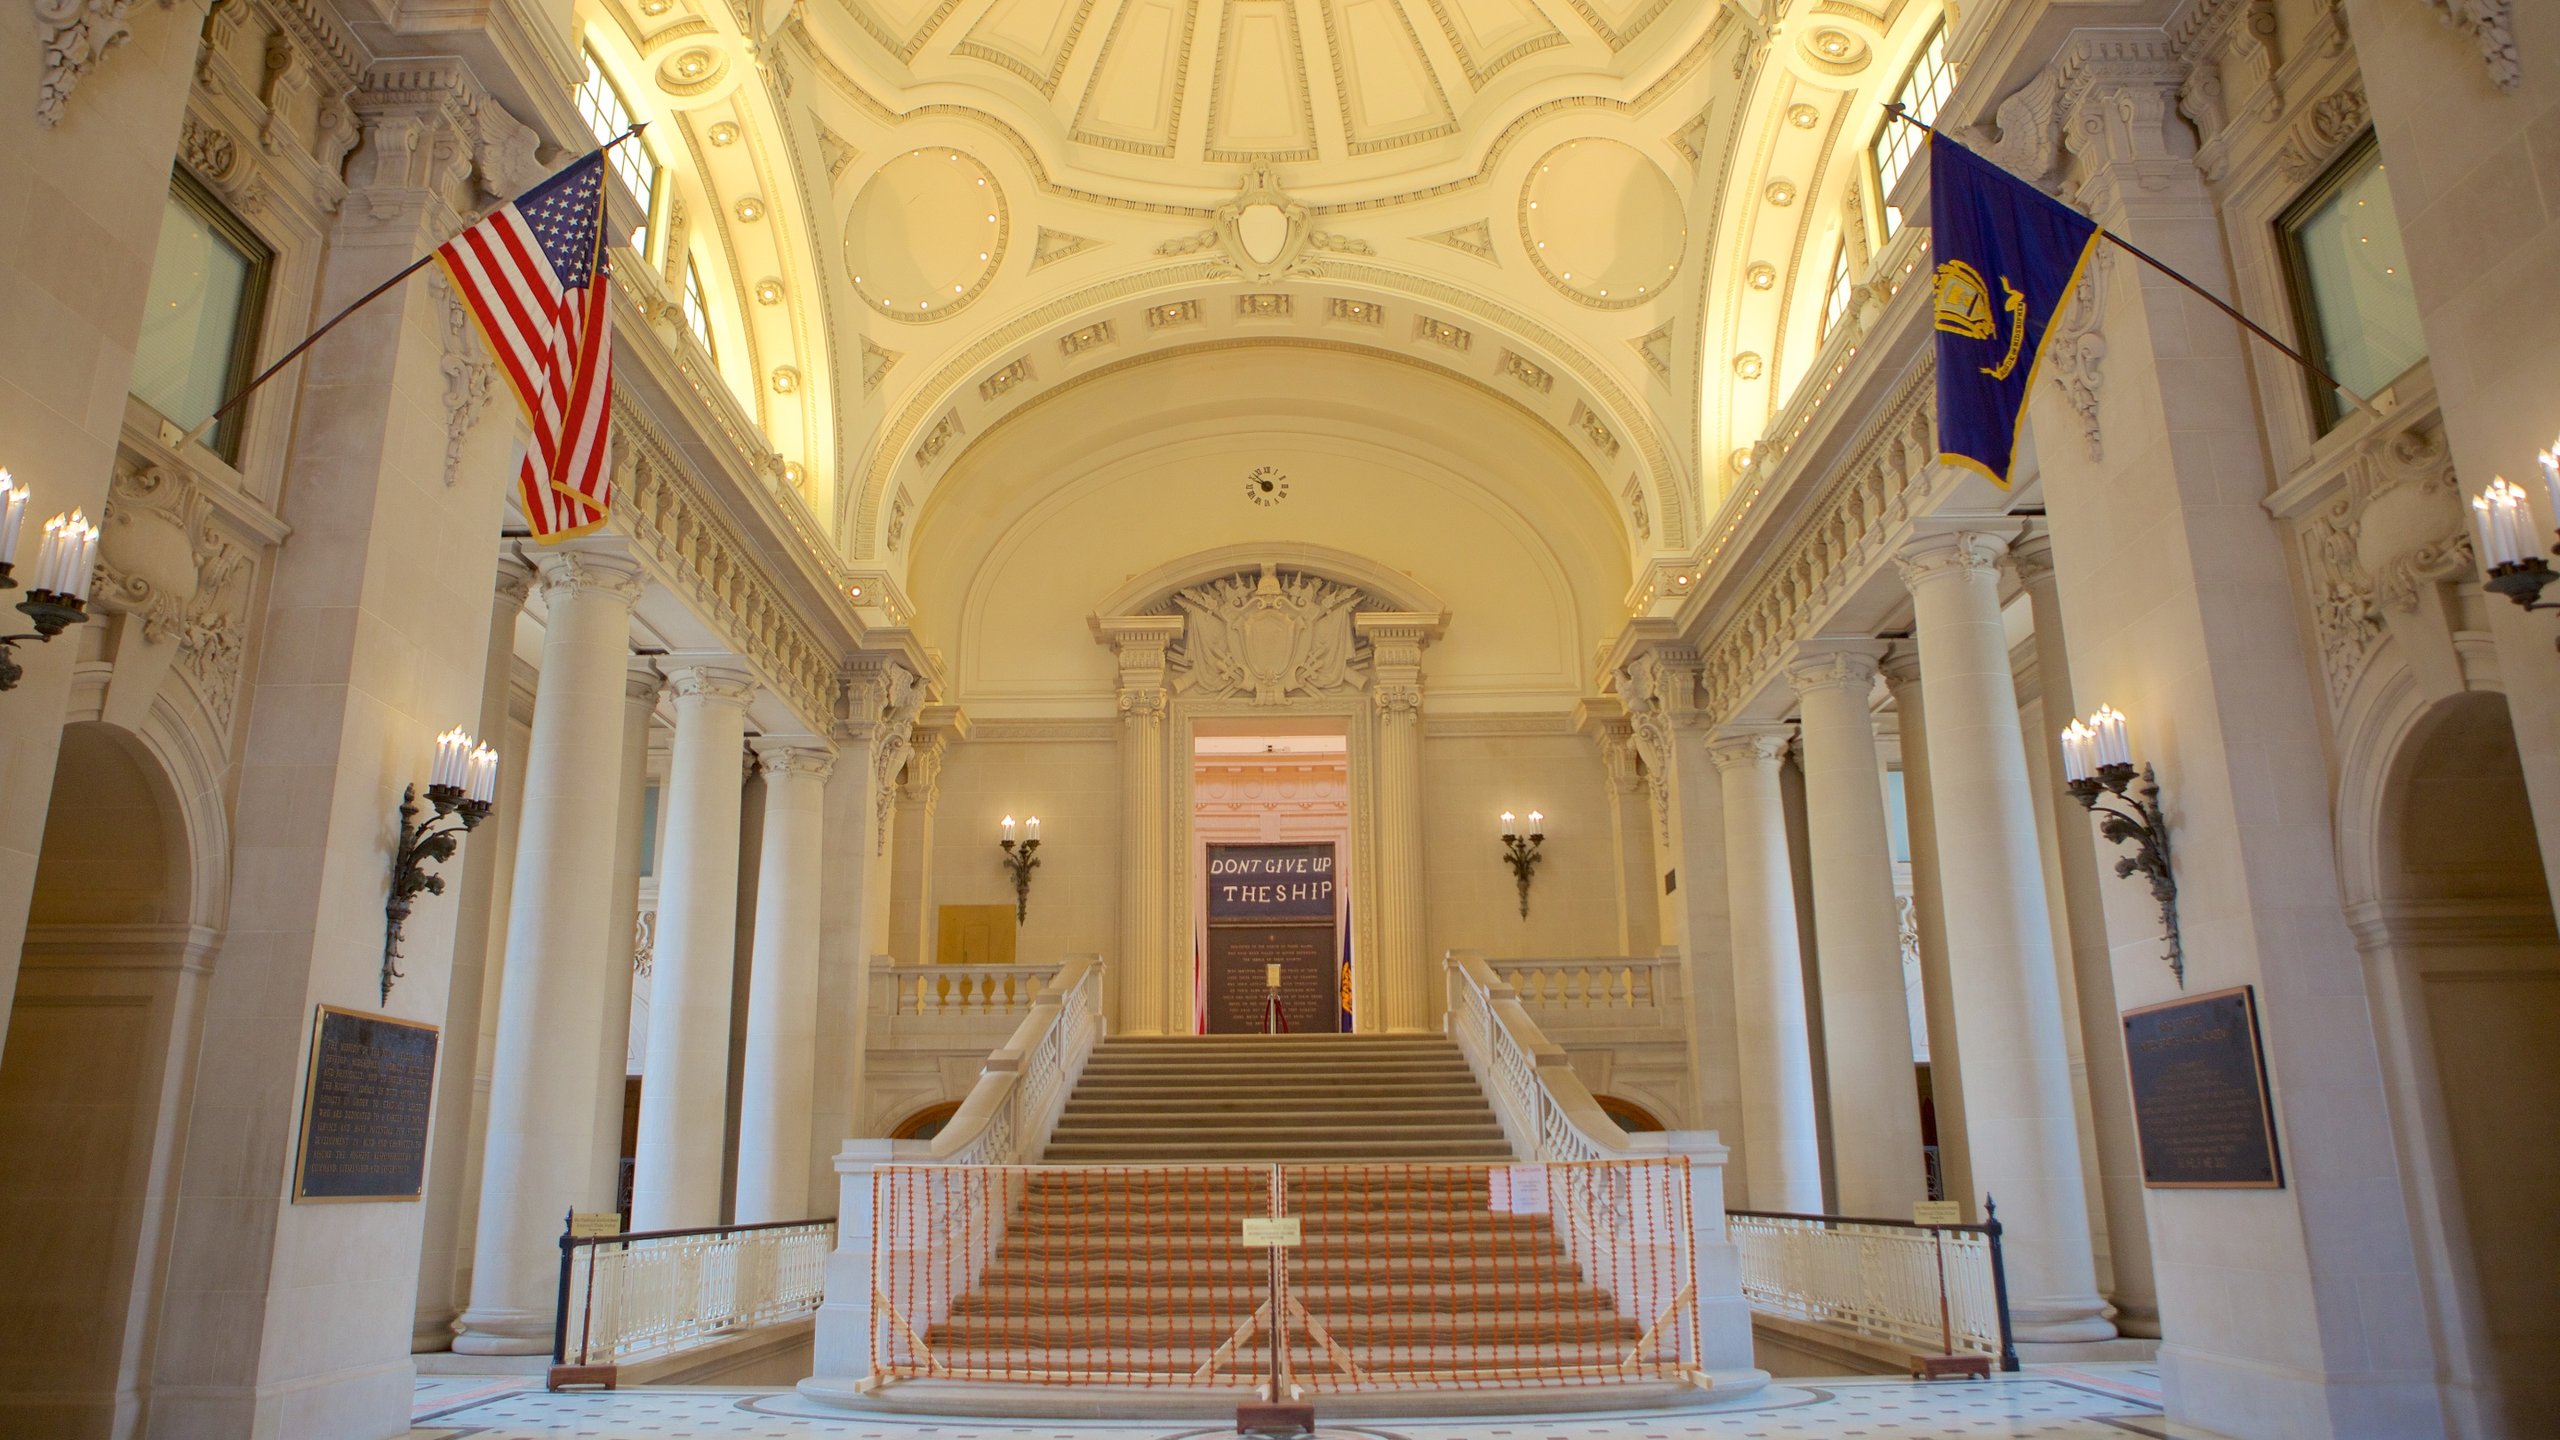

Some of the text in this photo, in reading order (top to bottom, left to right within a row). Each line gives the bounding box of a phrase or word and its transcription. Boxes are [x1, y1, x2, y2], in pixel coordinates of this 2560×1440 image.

[1211, 857, 1332, 874] DONT GIVE UP
[1223, 881, 1332, 903] THE SHIP
